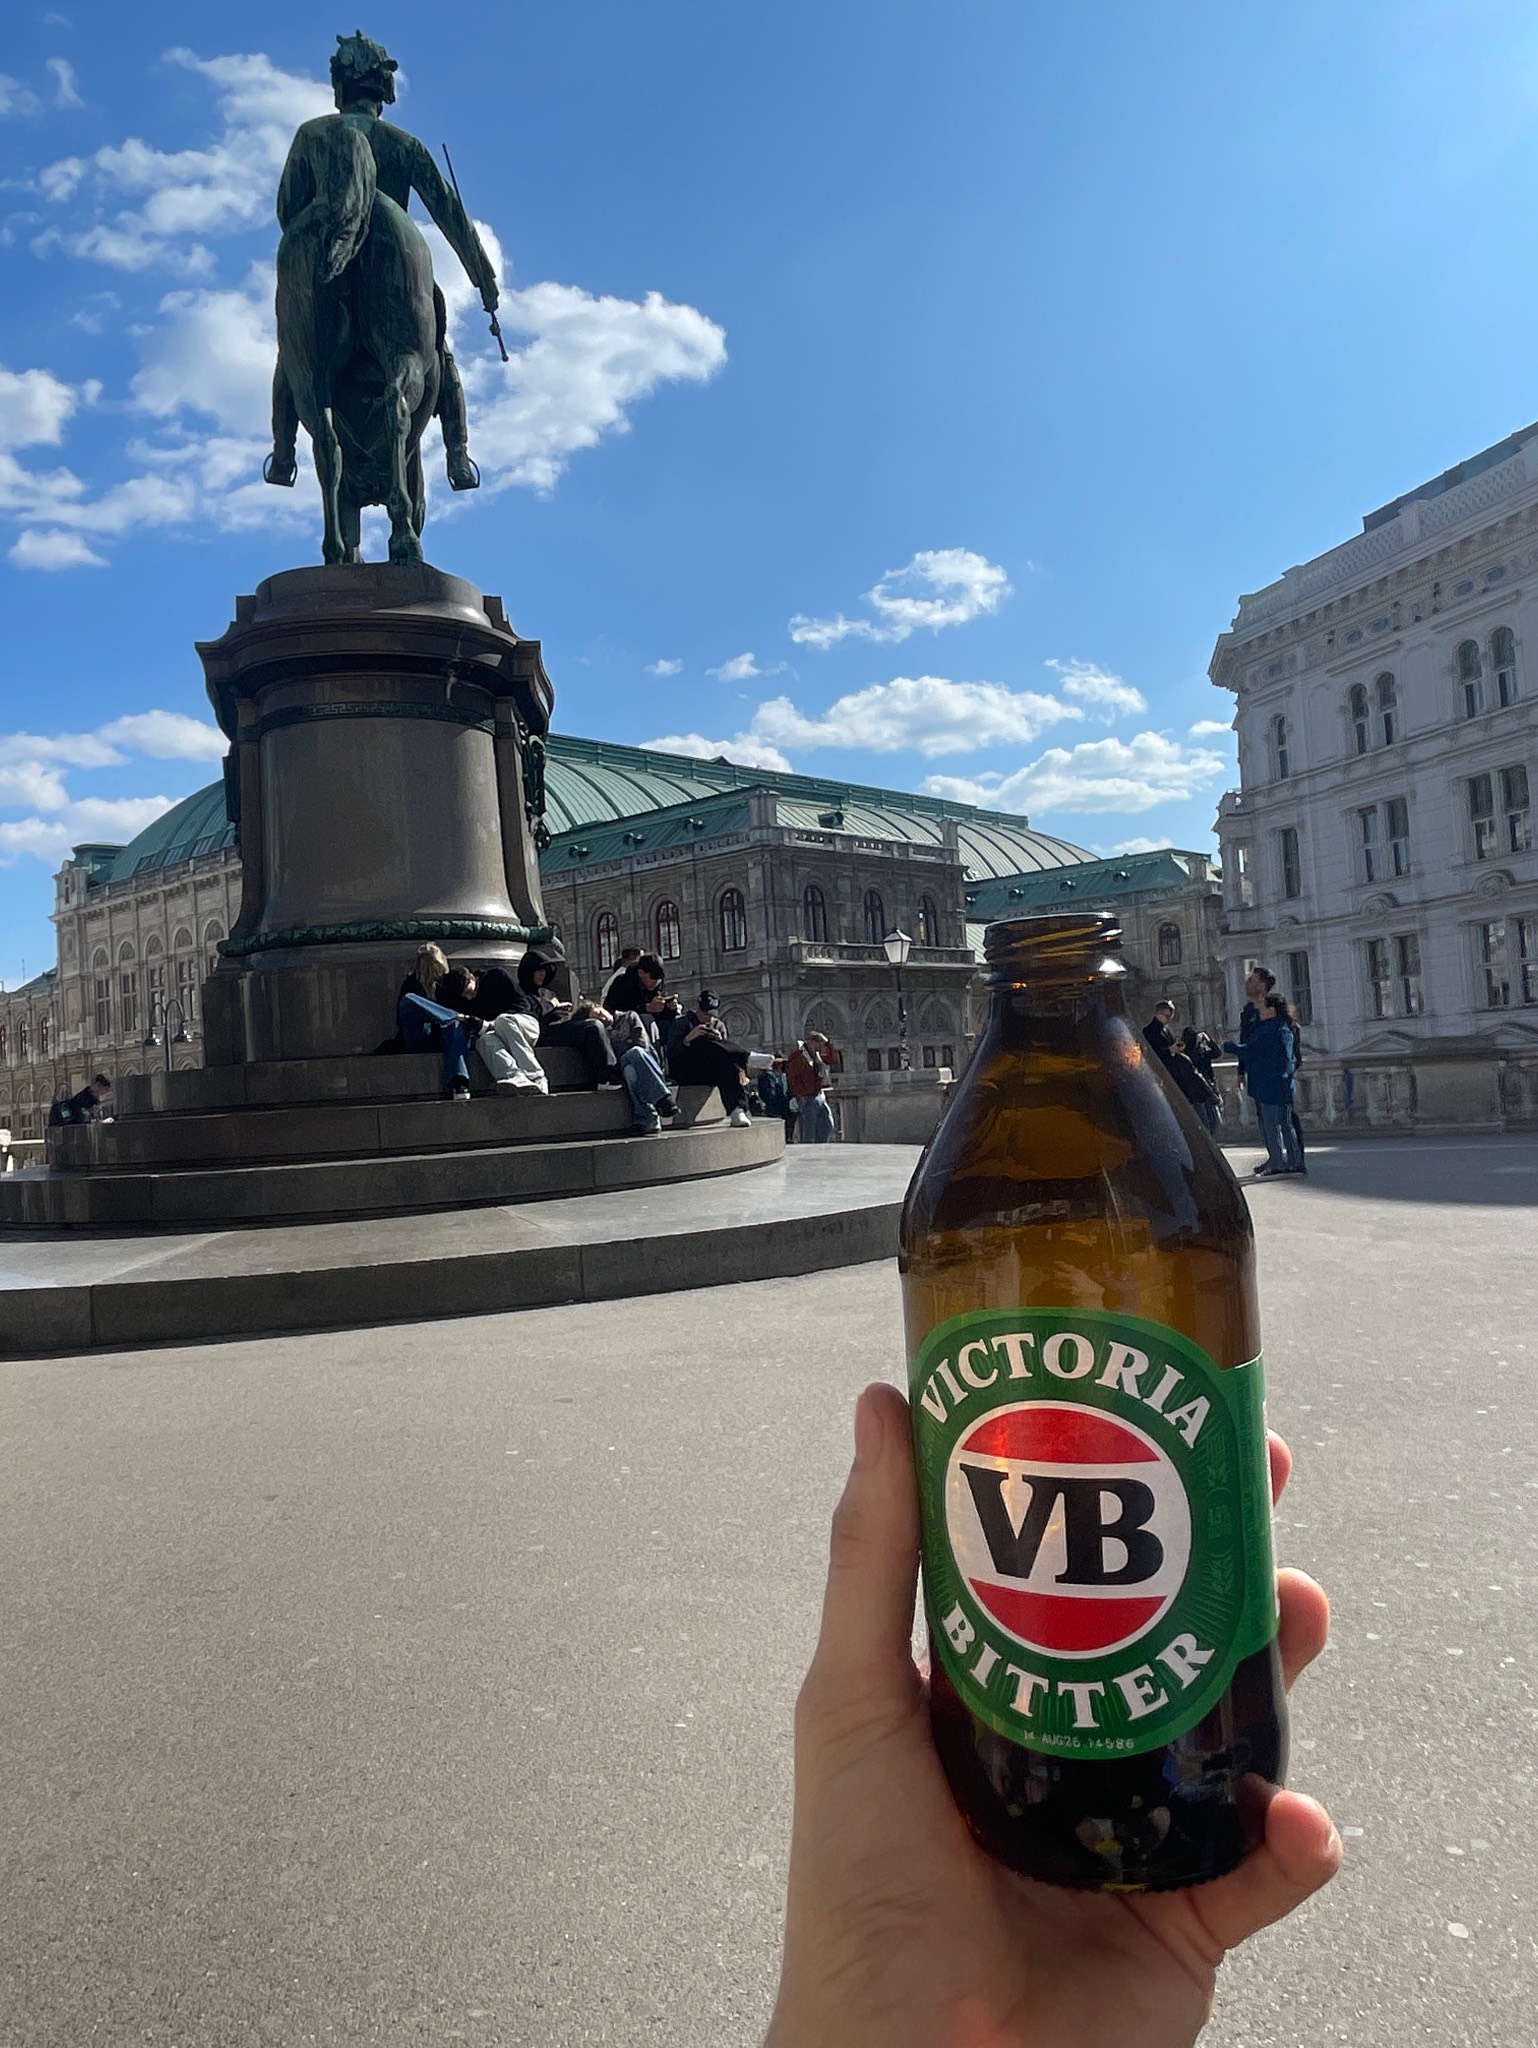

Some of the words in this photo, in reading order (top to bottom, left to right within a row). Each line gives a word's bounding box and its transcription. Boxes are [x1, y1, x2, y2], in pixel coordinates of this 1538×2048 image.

[920, 1332, 1212, 1449] VICTORIA
[959, 1463, 1164, 1586] VB
[943, 1600, 1216, 1728] BITTER
